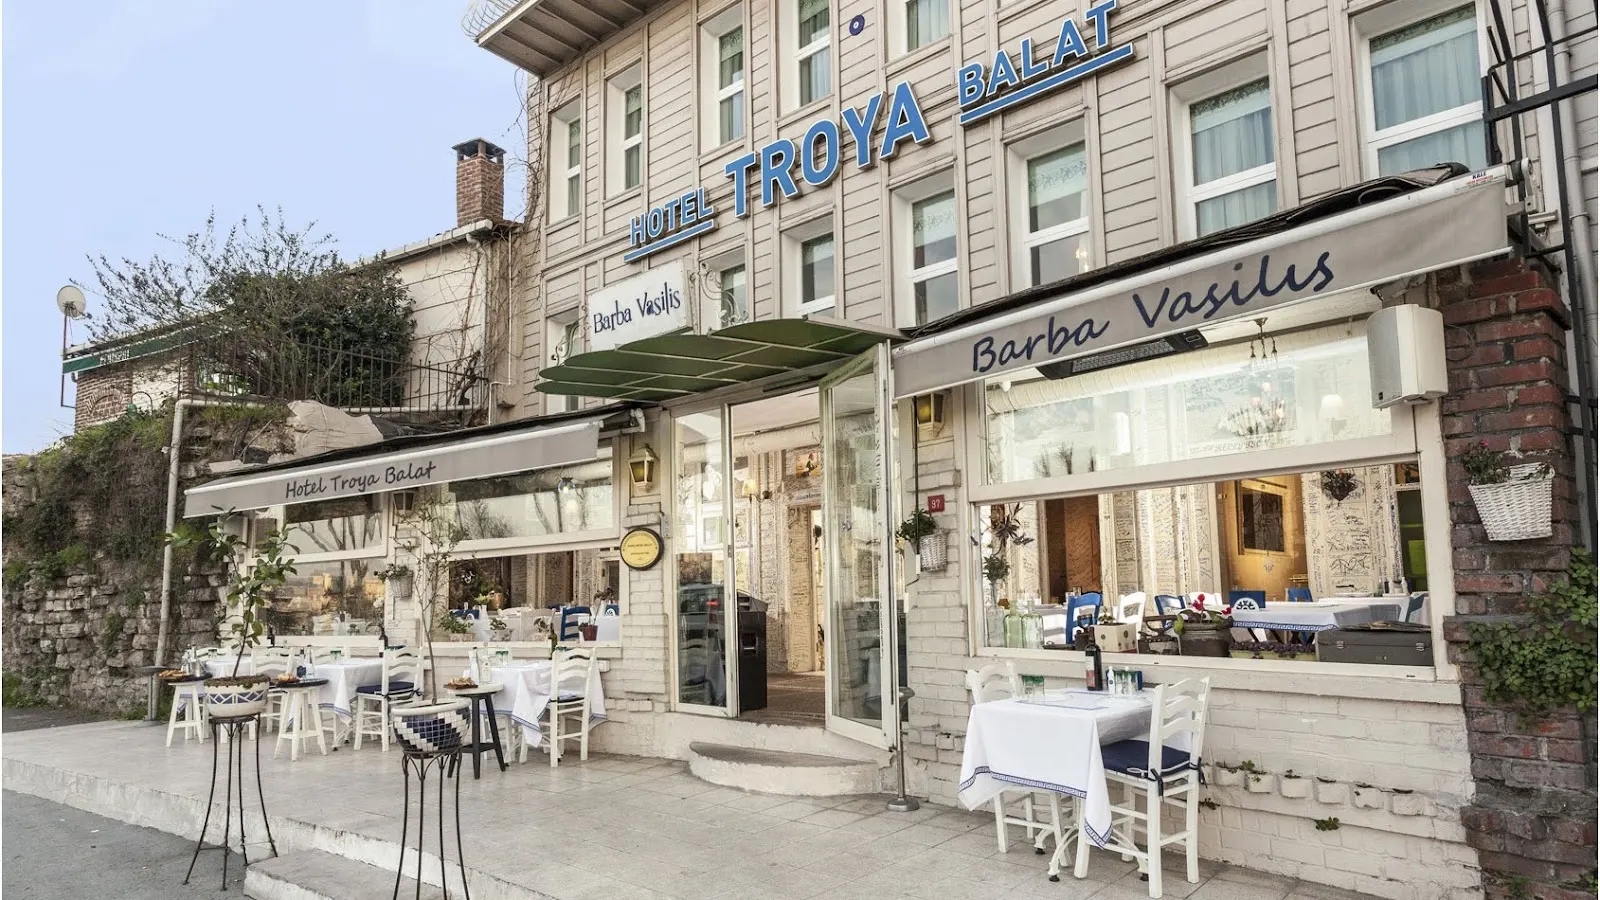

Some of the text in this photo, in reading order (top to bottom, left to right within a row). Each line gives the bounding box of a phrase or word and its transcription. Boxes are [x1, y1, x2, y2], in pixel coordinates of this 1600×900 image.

[629, 0, 1118, 247] HOTEL TROYA BALAT
[593, 281, 681, 334] Barba Vasilis
[971, 315, 1111, 374] Barba
[285, 461, 436, 499] Hotel Troya Balat
